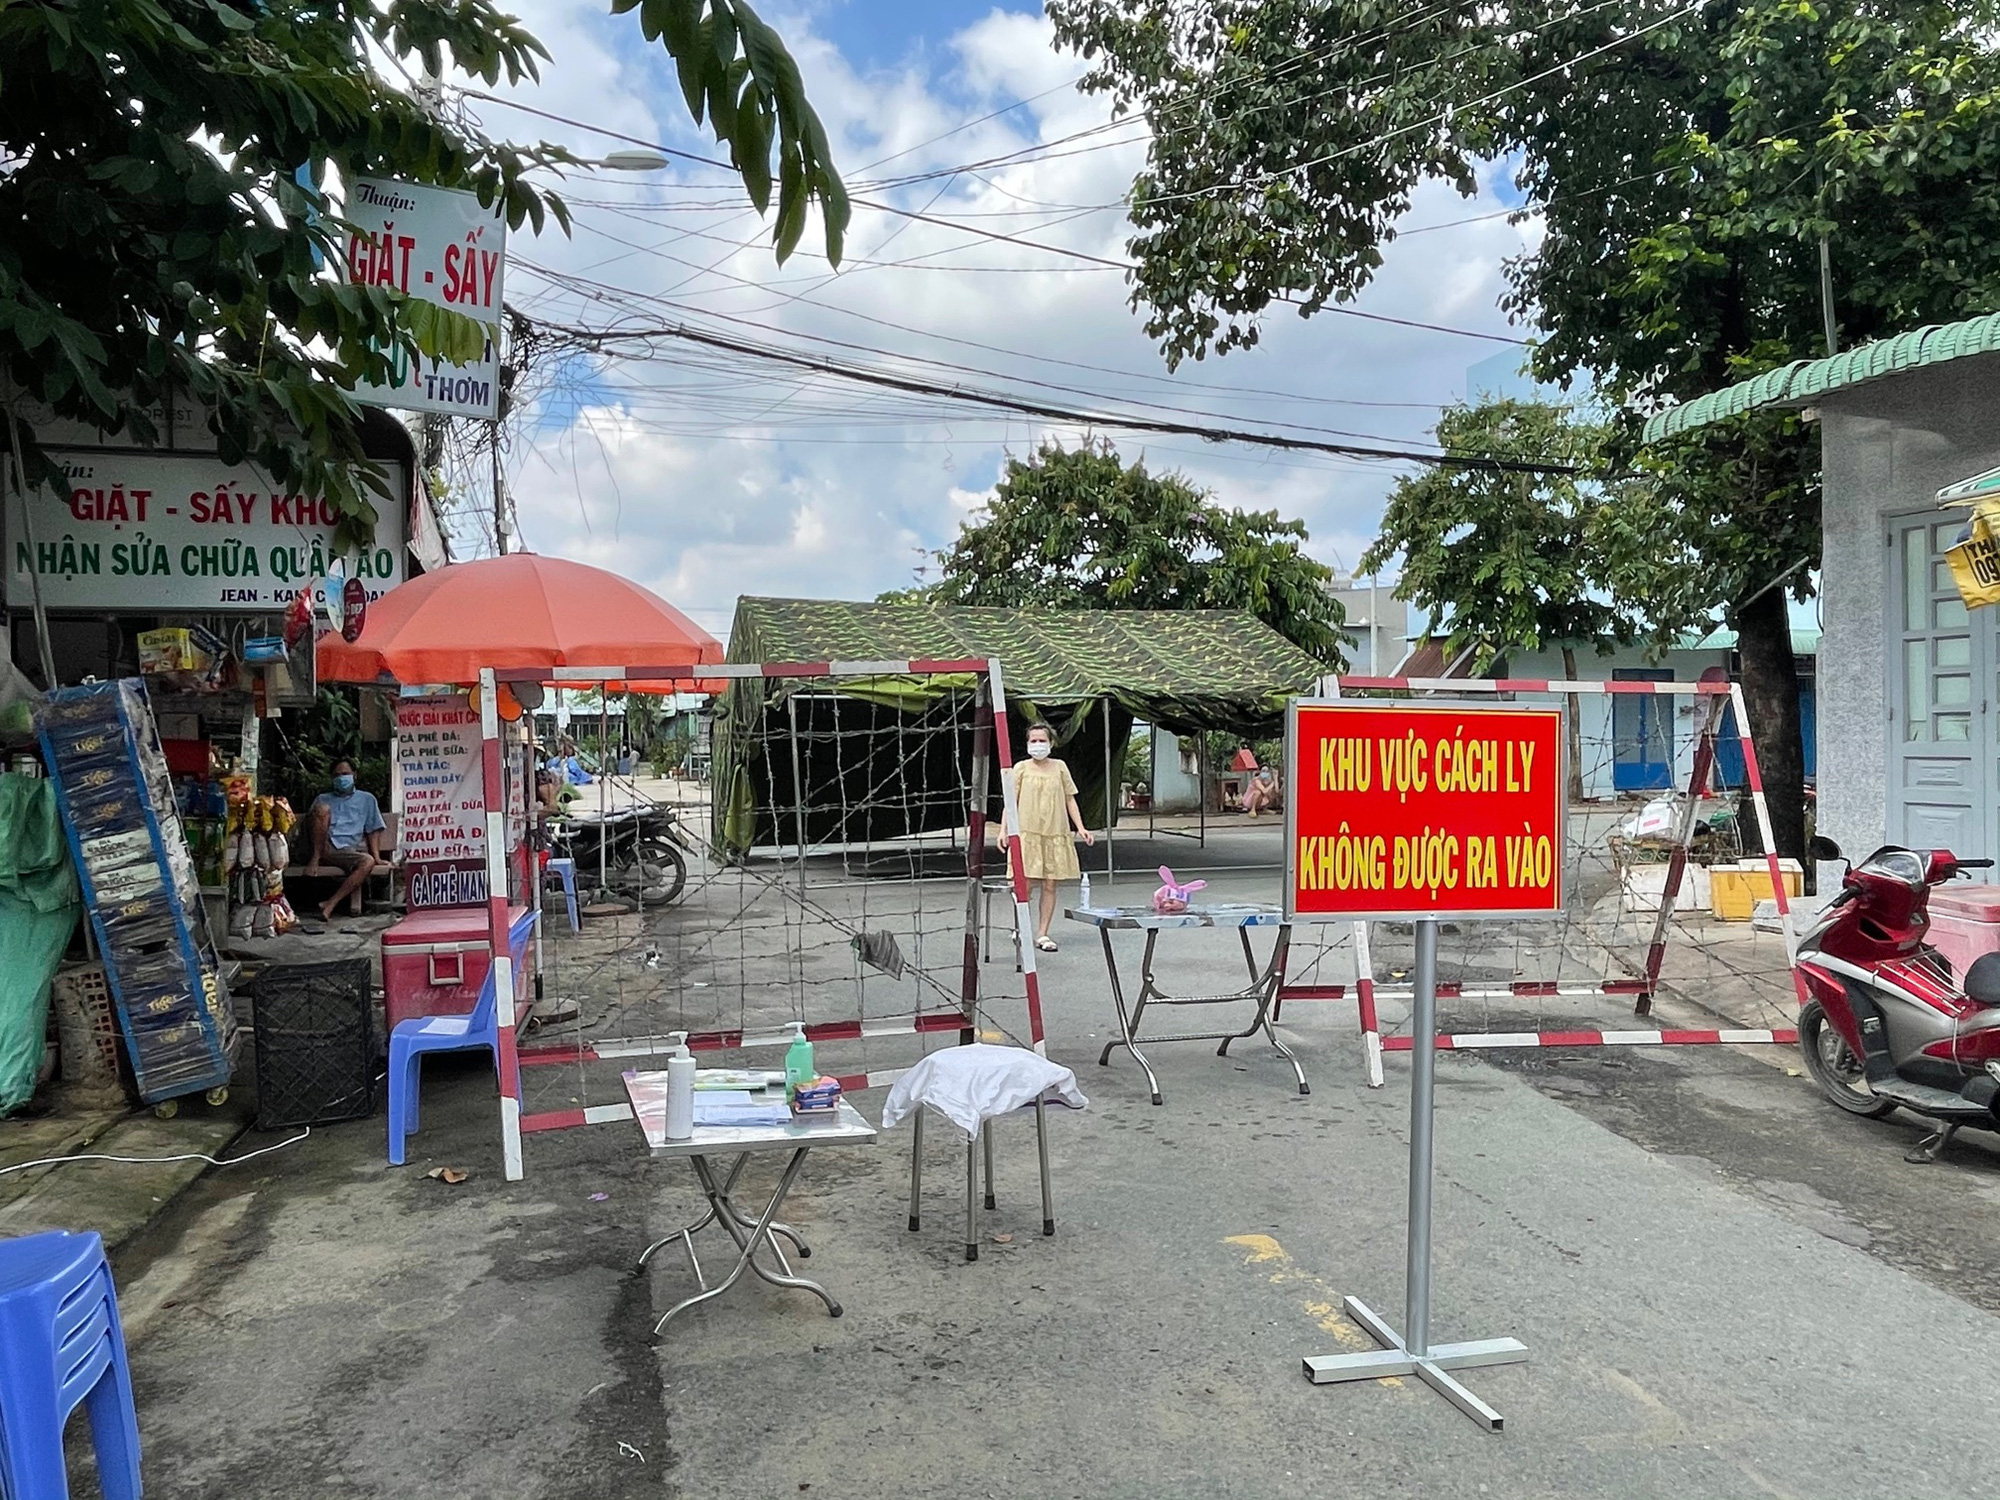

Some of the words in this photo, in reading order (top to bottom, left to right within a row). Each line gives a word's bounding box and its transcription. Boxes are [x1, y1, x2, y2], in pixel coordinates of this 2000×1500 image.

[354, 183, 416, 213] Thuận:
[442, 225, 499, 308] SẤY
[424, 374, 490, 407] THƠM
[70, 483, 153, 531] GIẶT
[189, 480, 258, 524] SẤY
[16, 534, 101, 581] NHẬN
[111, 531, 172, 576] SỬA
[181, 538, 260, 577] CHỮA
[219, 589, 258, 603] JEAN
[404, 776, 439, 786] CHANH
[1319, 737, 1372, 793] KHU
[1379, 728, 1428, 804] VỰC
[1435, 725, 1498, 793] CÁCH
[1506, 741, 1536, 793] LY
[406, 790, 427, 800] CAM
[406, 830, 435, 843] RAU
[441, 825, 466, 840] MÁ
[405, 847, 440, 859] XANH
[1299, 821, 1386, 891] KHÔNG
[1393, 825, 1459, 901] ĐƯỢC
[1466, 836, 1498, 889] RA
[1506, 821, 1551, 889] VÀO
[431, 864, 458, 905] PHÊ
